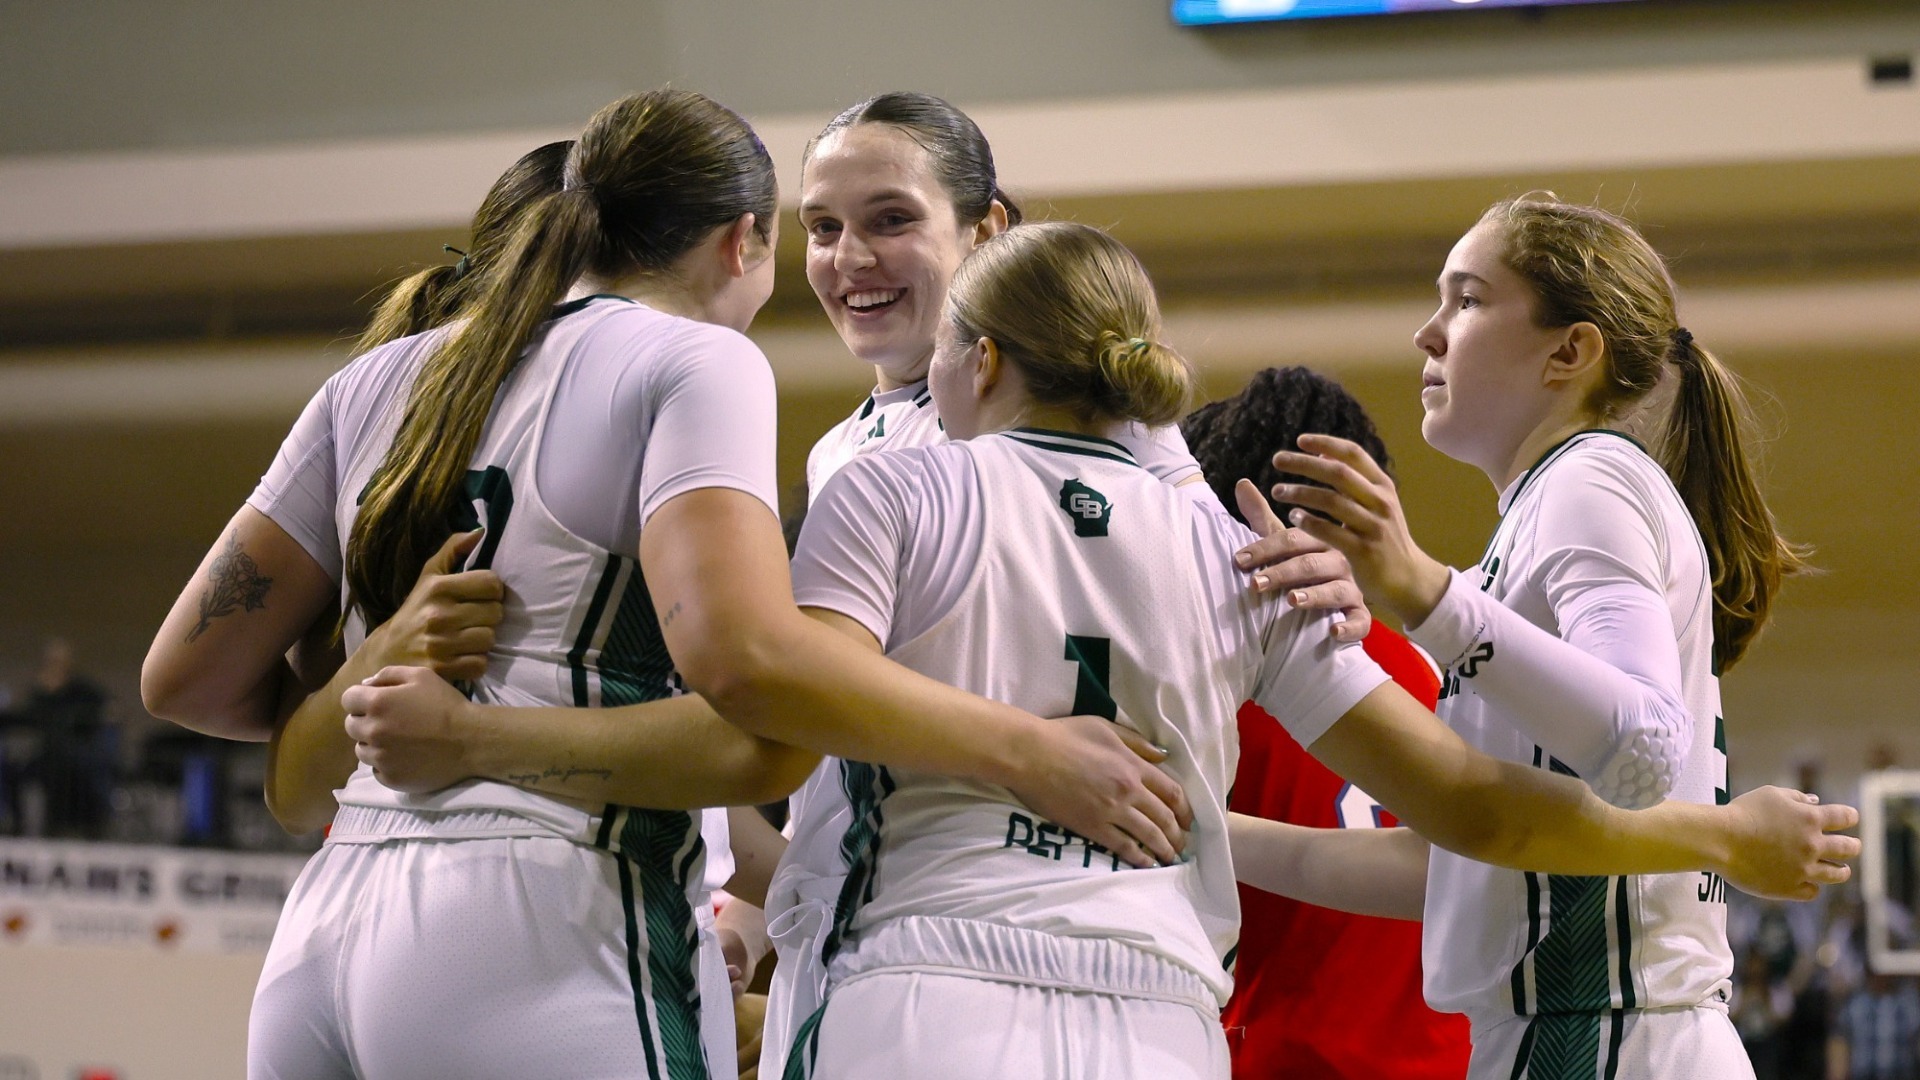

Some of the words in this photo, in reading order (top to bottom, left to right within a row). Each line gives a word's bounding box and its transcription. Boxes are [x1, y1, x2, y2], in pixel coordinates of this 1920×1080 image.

[1070, 493, 1102, 518] GB
[1064, 633, 1117, 722] 1
[542, 763, 563, 779] the
